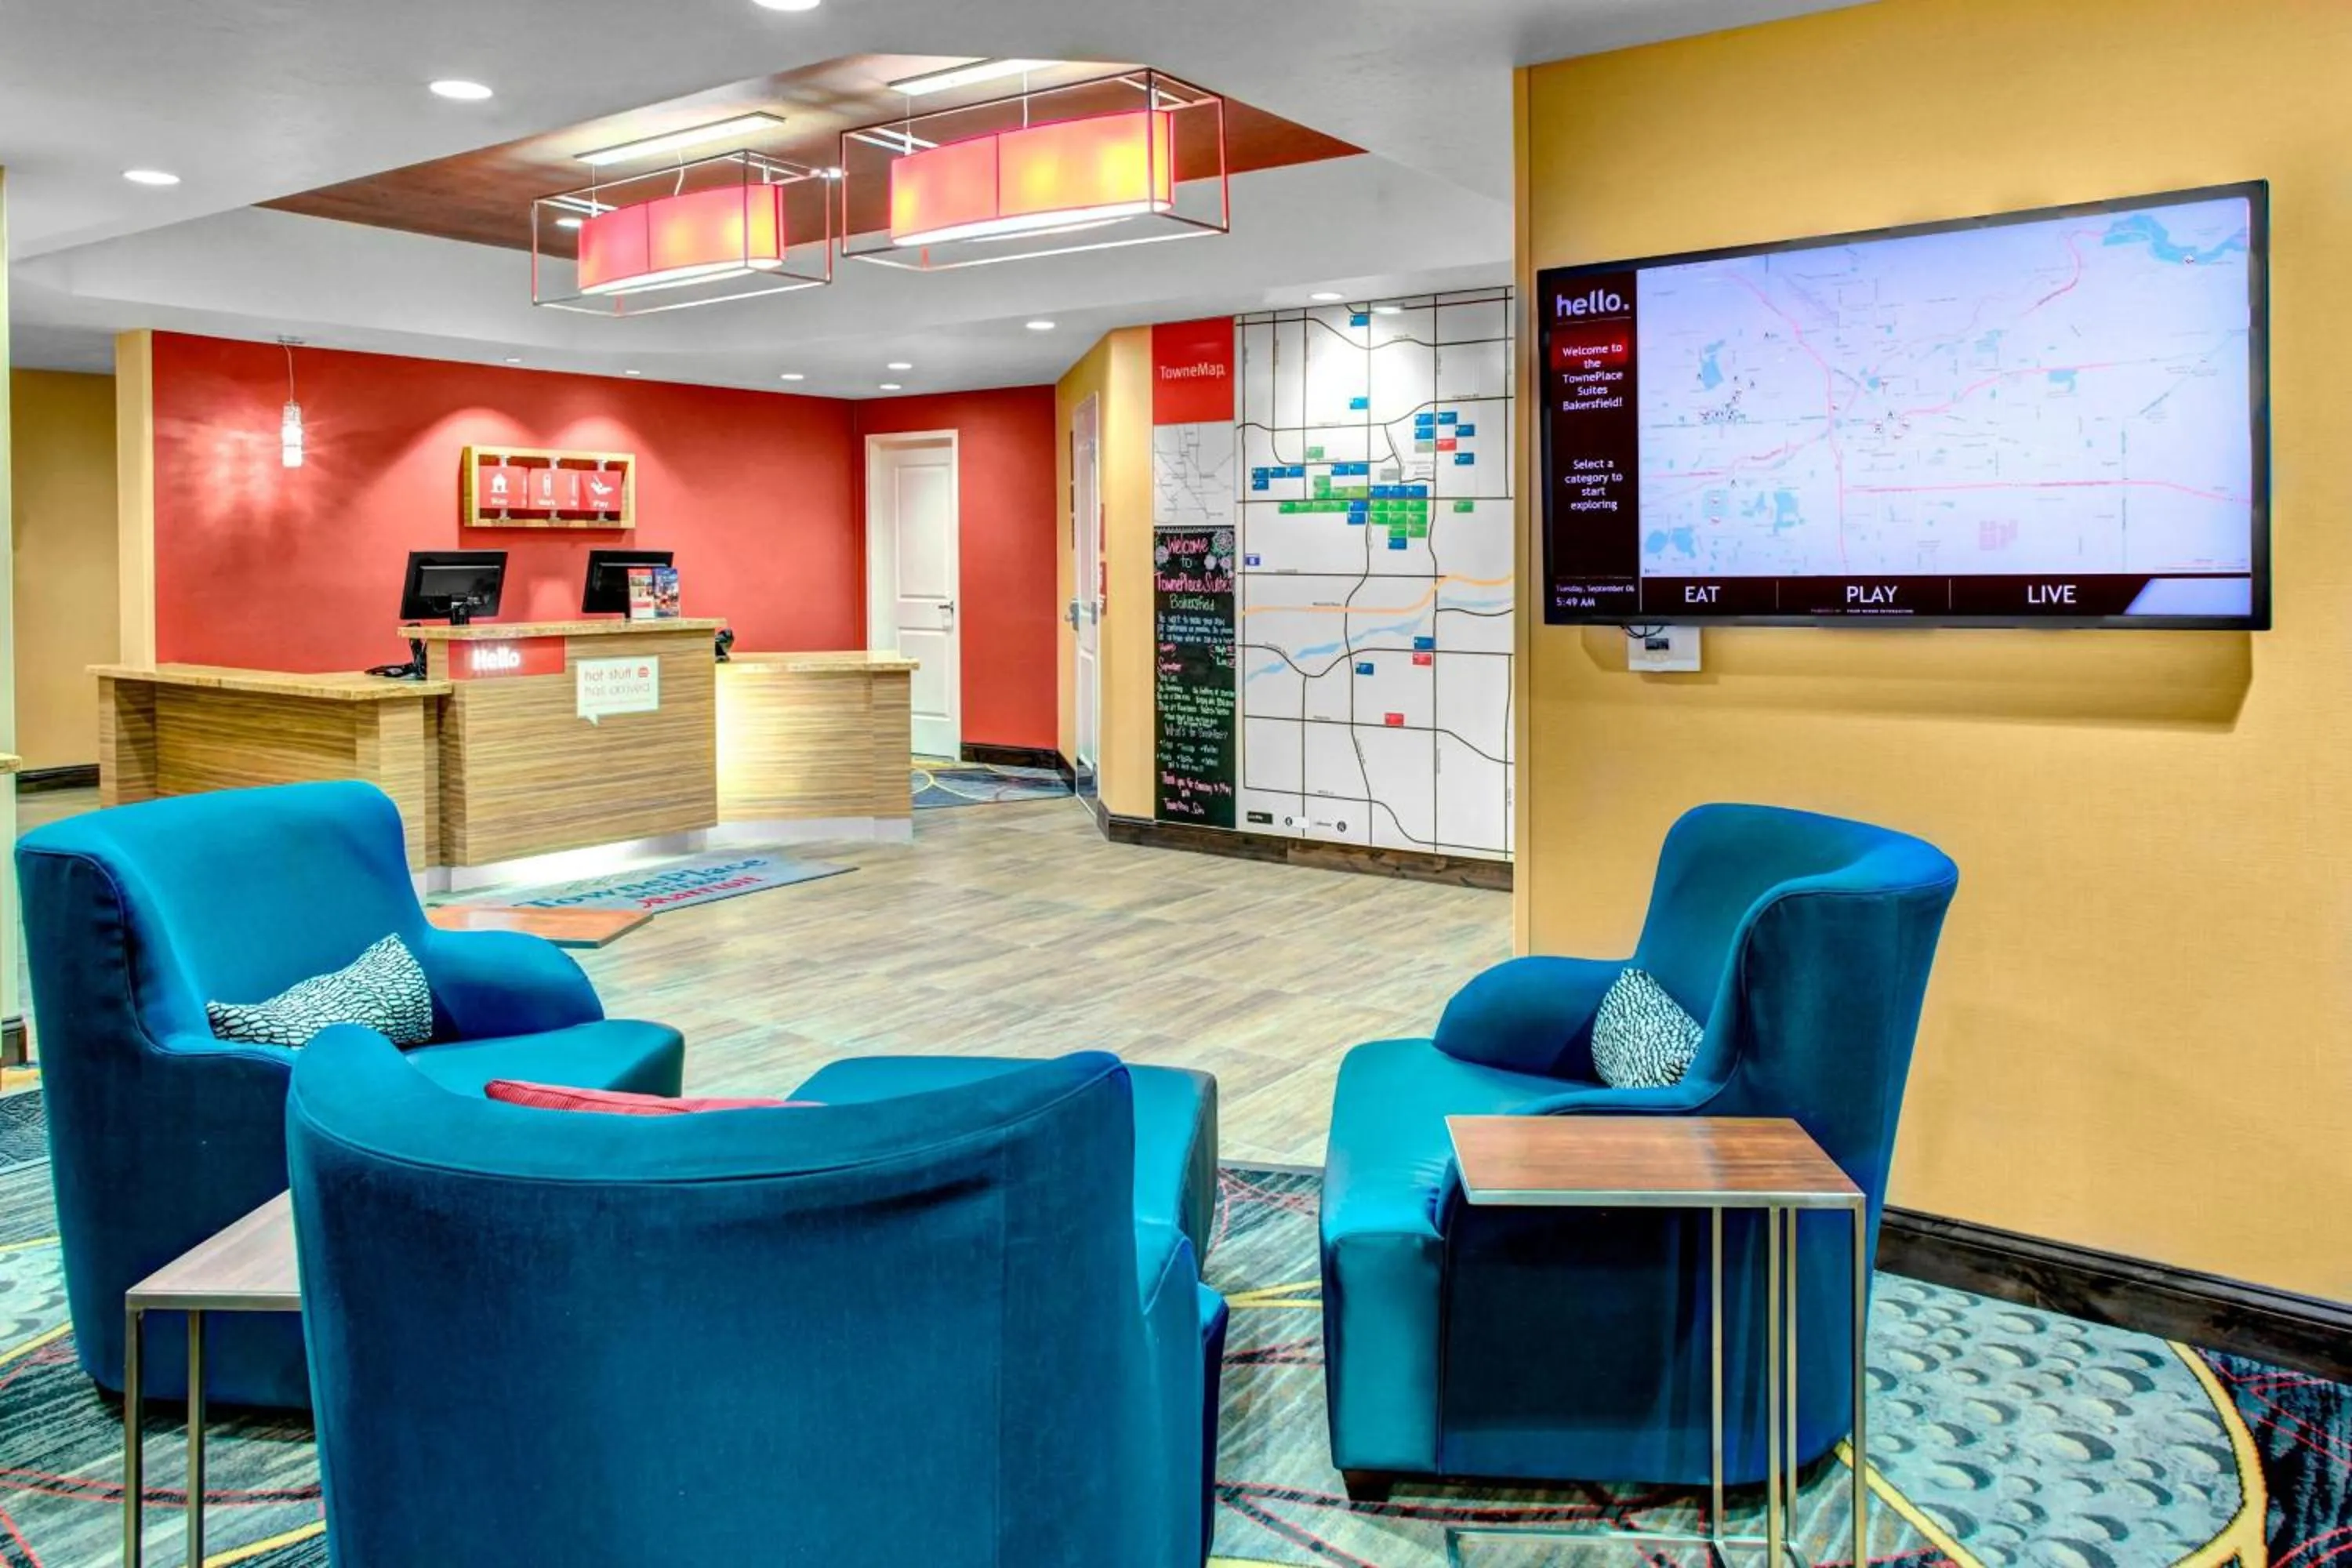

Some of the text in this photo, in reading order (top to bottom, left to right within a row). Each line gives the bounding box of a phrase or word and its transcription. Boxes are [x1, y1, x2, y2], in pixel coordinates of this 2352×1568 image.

[1556, 289, 1630, 317] hello.
[1563, 343, 1624, 358] Welcome to
[1160, 361, 1226, 380] TowneMap
[1584, 359, 1602, 369] the
[1563, 371, 1624, 383] TownePlace
[1577, 386, 1608, 396] Suites
[1563, 397, 1623, 412] Bakersfield!
[1573, 459, 1614, 470] Select a
[1564, 473, 1623, 485] category to
[1581, 487, 1606, 496] start
[1570, 499, 1618, 512] exploring
[1588, 583, 1624, 593] September
[1625, 584, 1635, 593] 06
[1685, 586, 1721, 603] EAT
[1846, 585, 1897, 603] PLAY
[2027, 584, 2078, 604] LIVE
[1555, 597, 1596, 608] 5:49 AM
[472, 646, 521, 669] Hello
[584, 667, 632, 682] hot stuff
[584, 681, 651, 697] has arrived
[512, 858, 768, 907] TownePlace
